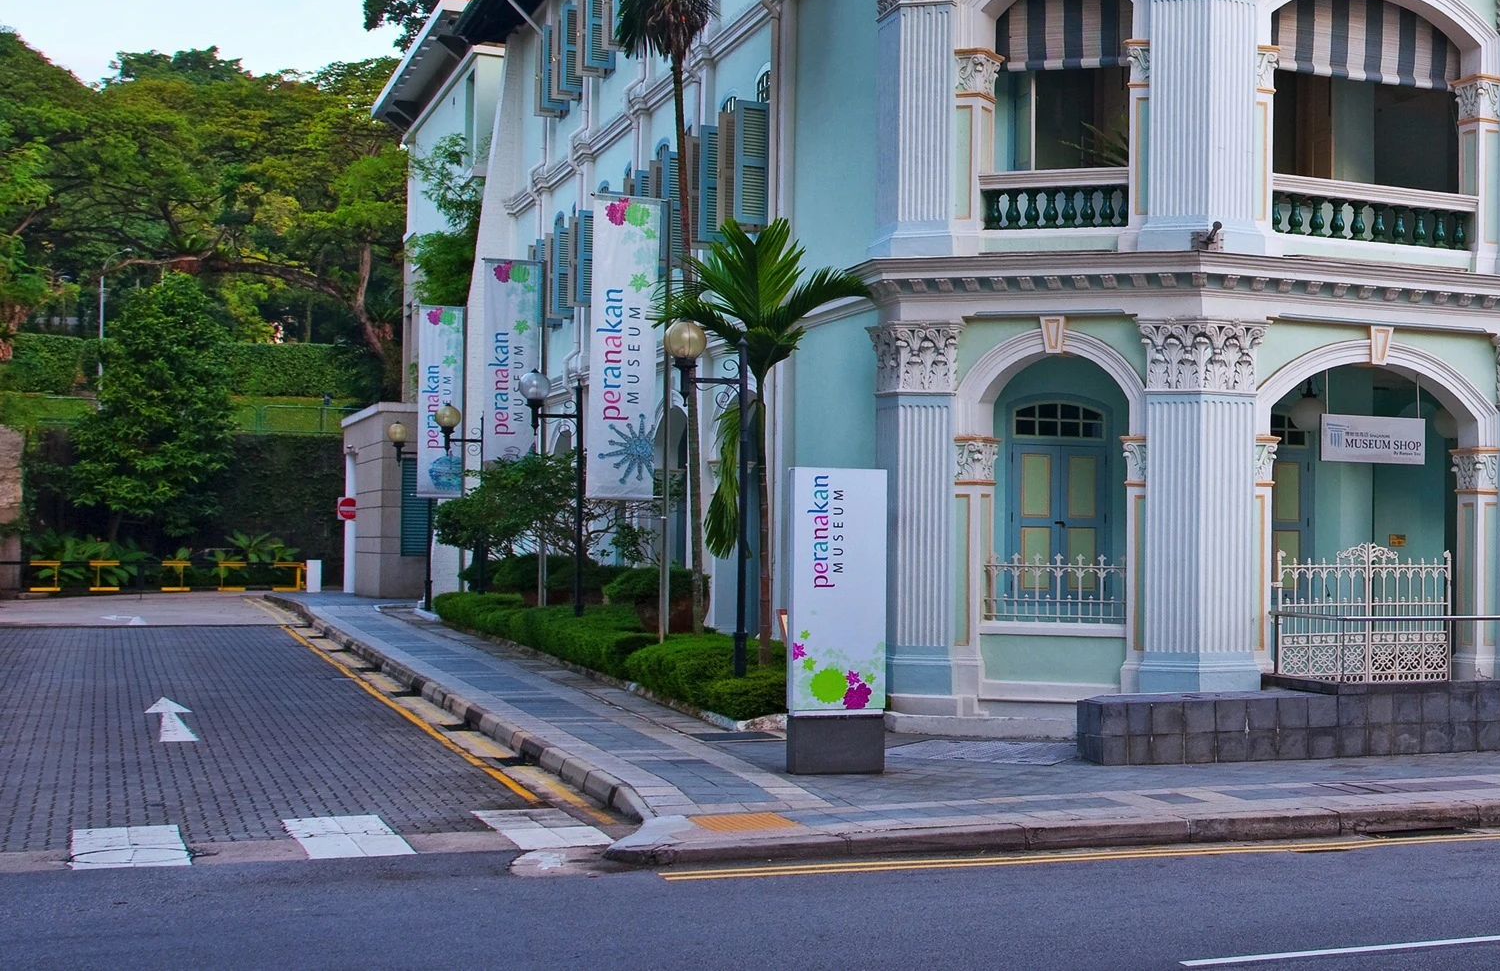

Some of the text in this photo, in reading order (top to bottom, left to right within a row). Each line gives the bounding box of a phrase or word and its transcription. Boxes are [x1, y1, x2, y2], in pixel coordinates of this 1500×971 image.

[487, 331, 516, 436] peranakan
[596, 288, 629, 421] peranakan
[626, 306, 641, 405] MUSEUM
[1345, 438, 1422, 451] MUSEUM SHOP
[806, 474, 836, 589] peranakan
[833, 489, 844, 574] MUSEUM
